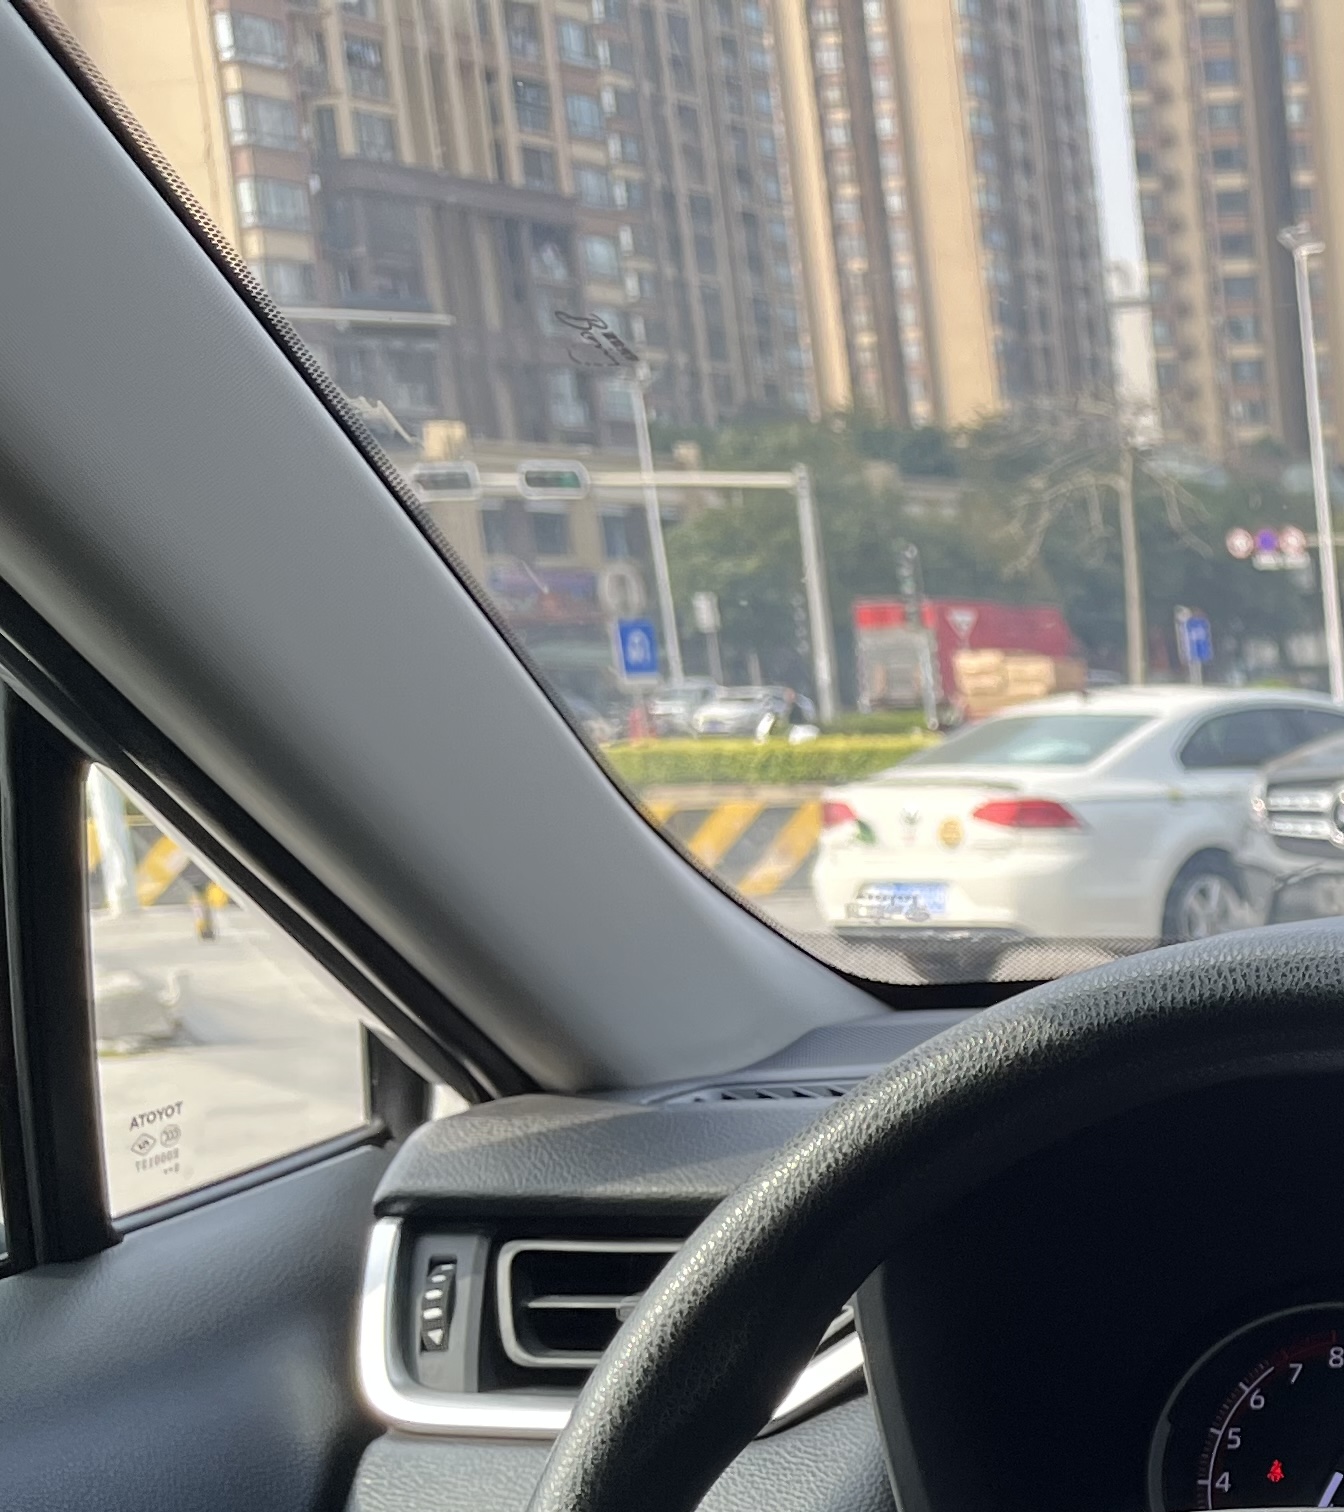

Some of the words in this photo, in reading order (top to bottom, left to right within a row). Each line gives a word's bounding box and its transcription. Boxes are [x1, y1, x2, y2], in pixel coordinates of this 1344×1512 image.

[1328, 1346, 1344, 1368] 8
[1289, 1362, 1303, 1384] 7
[1249, 1388, 1265, 1410] 6
[1227, 1427, 1241, 1449] 5
[1215, 1471, 1232, 1493] 4
